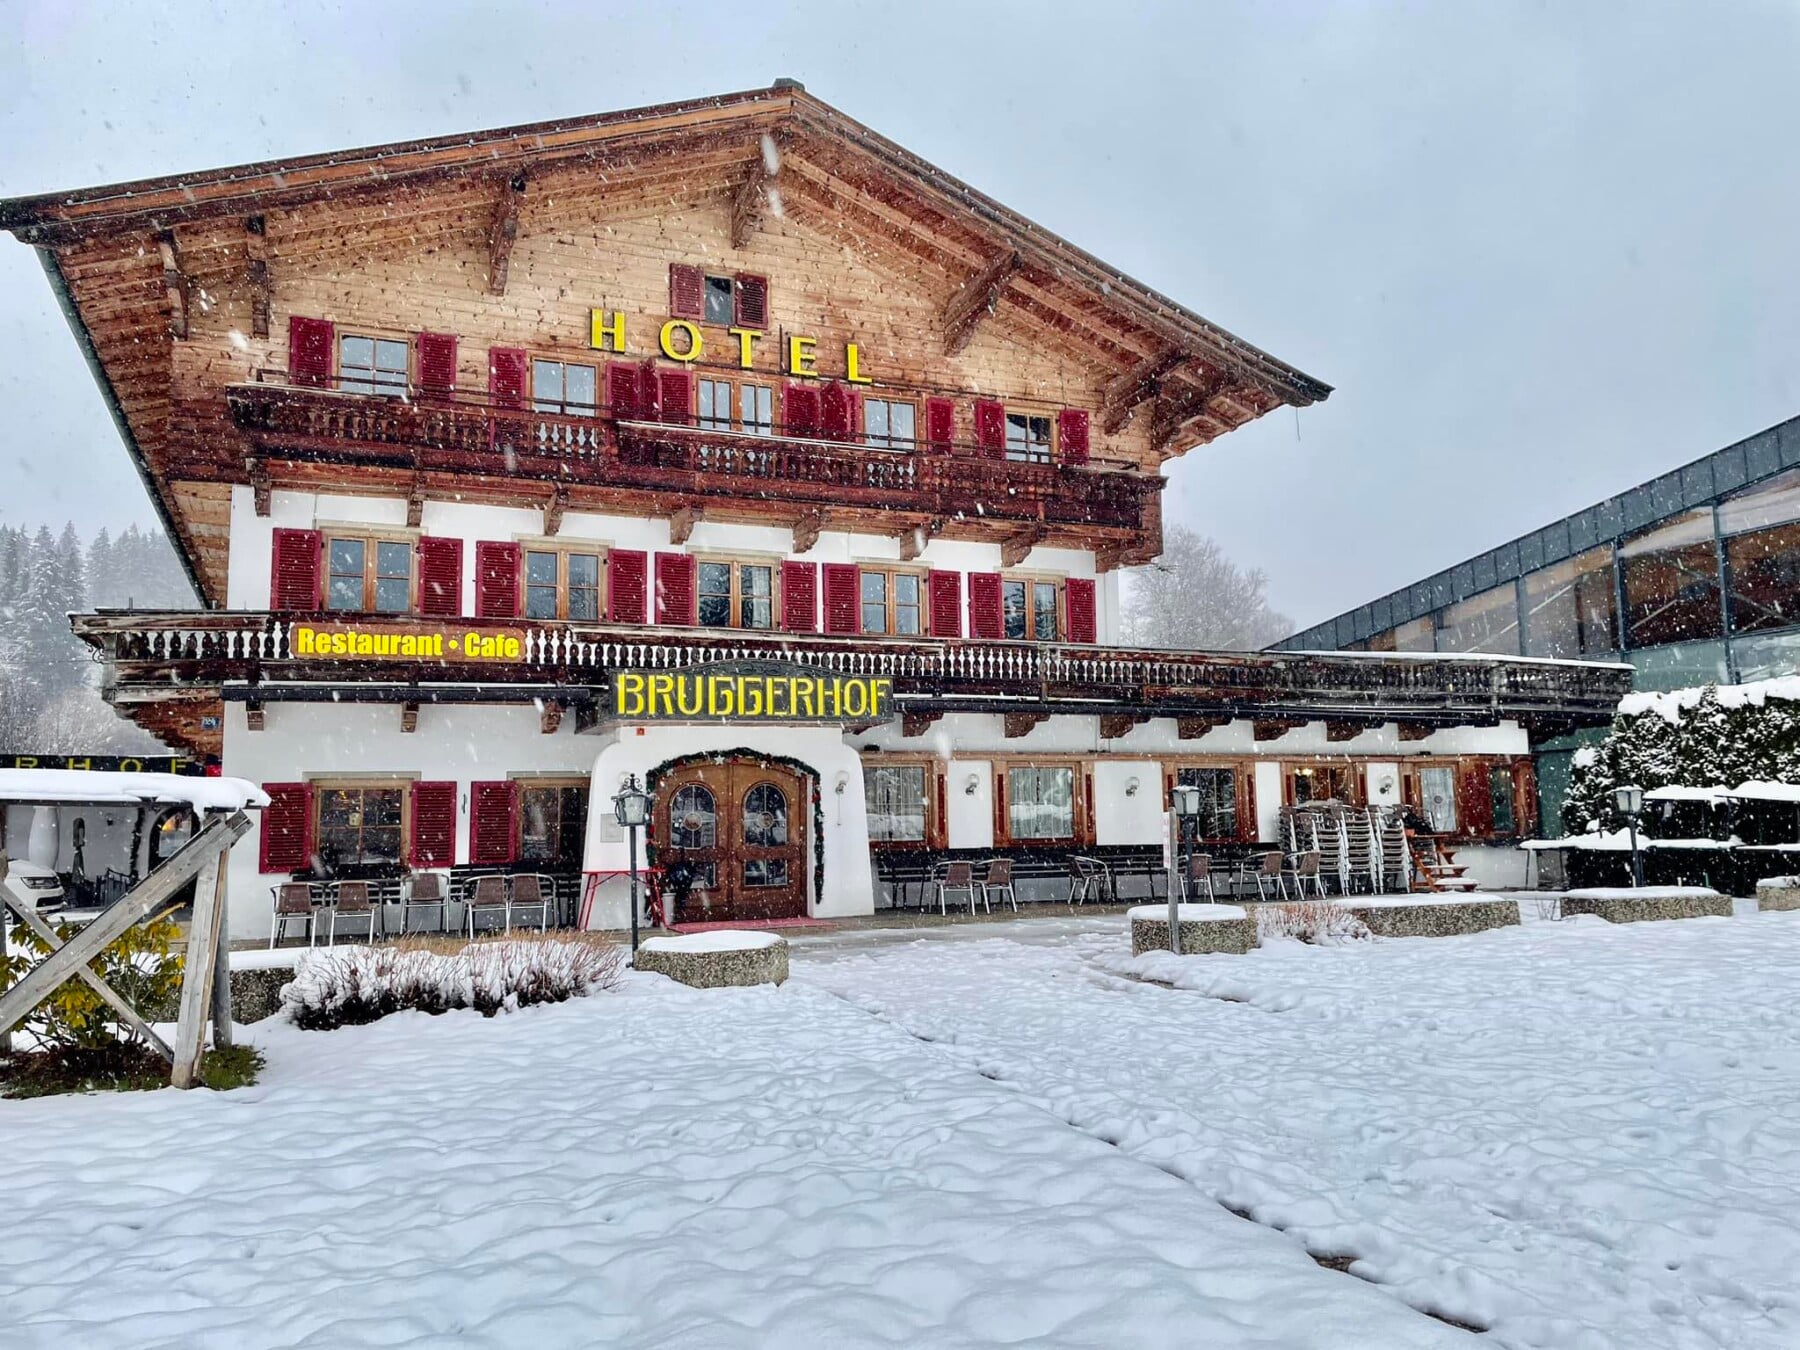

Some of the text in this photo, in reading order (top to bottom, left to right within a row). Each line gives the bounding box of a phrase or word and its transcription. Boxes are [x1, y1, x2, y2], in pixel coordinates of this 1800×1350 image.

[591, 308, 873, 384] HOTEL
[297, 628, 520, 659] Restaurant Cafe
[617, 673, 890, 718] BRUGGERHOF
